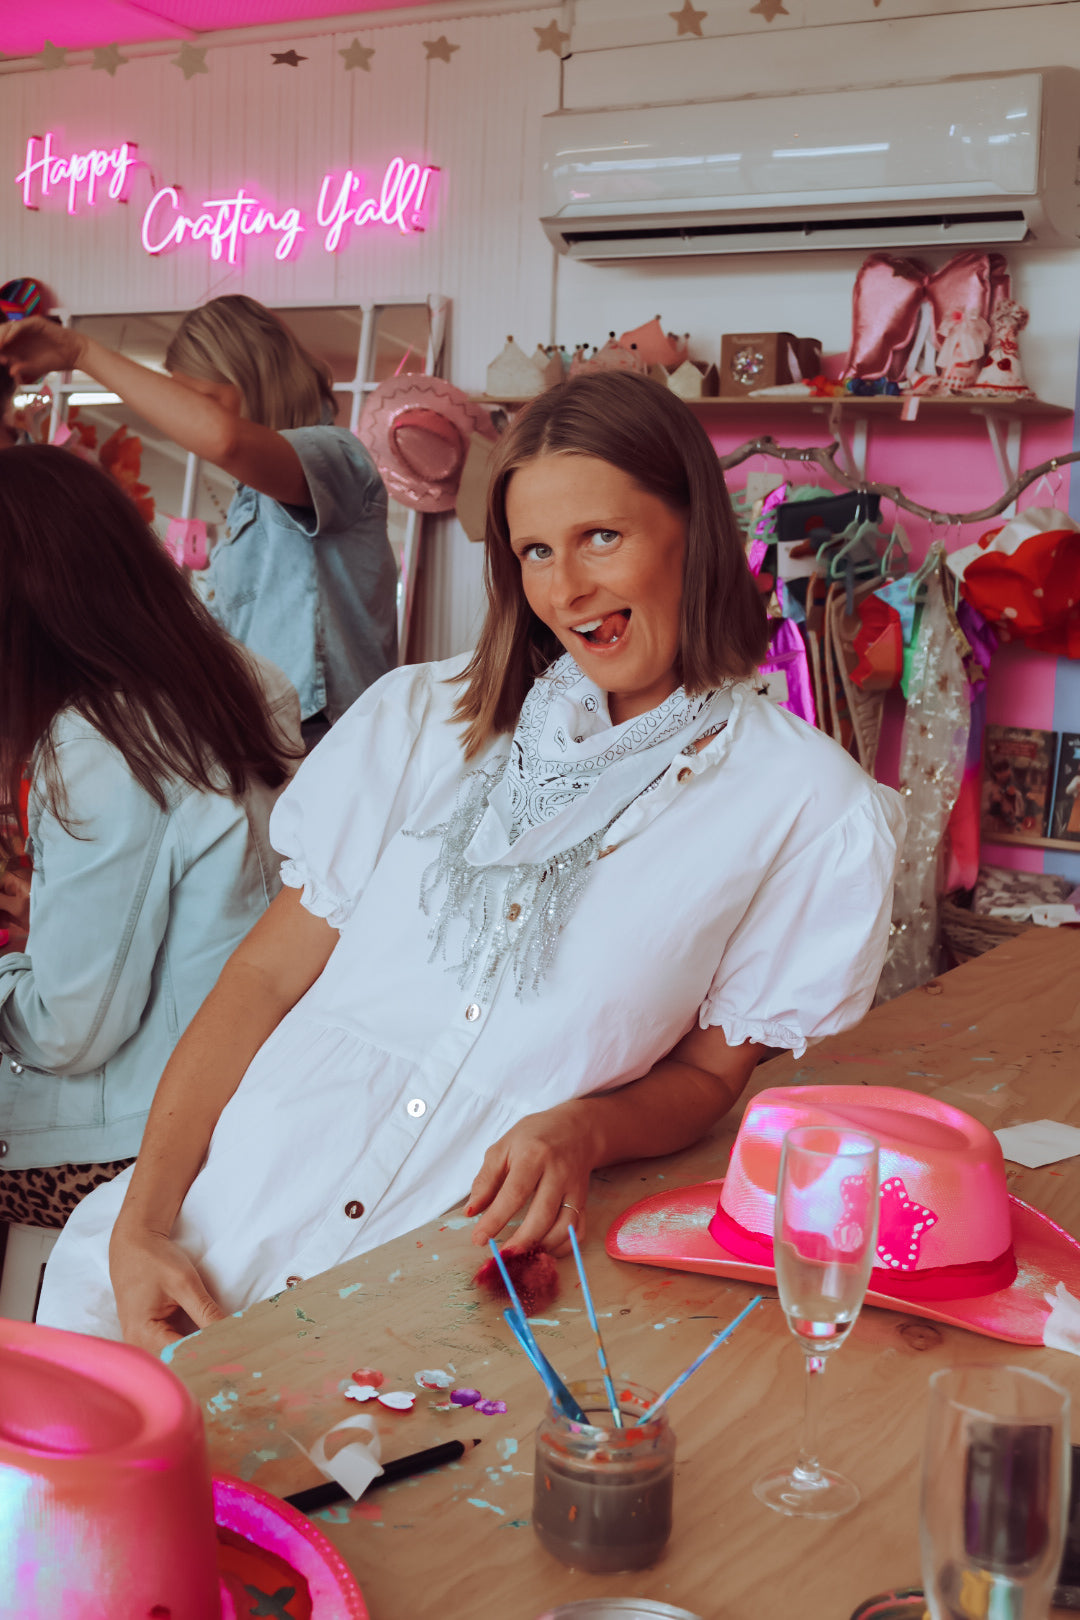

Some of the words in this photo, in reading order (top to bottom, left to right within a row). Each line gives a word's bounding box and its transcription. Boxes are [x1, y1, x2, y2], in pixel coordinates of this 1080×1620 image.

[16, 133, 133, 214] Happy
[142, 187, 304, 264] Crafting
[317, 157, 432, 252] Y'all!
